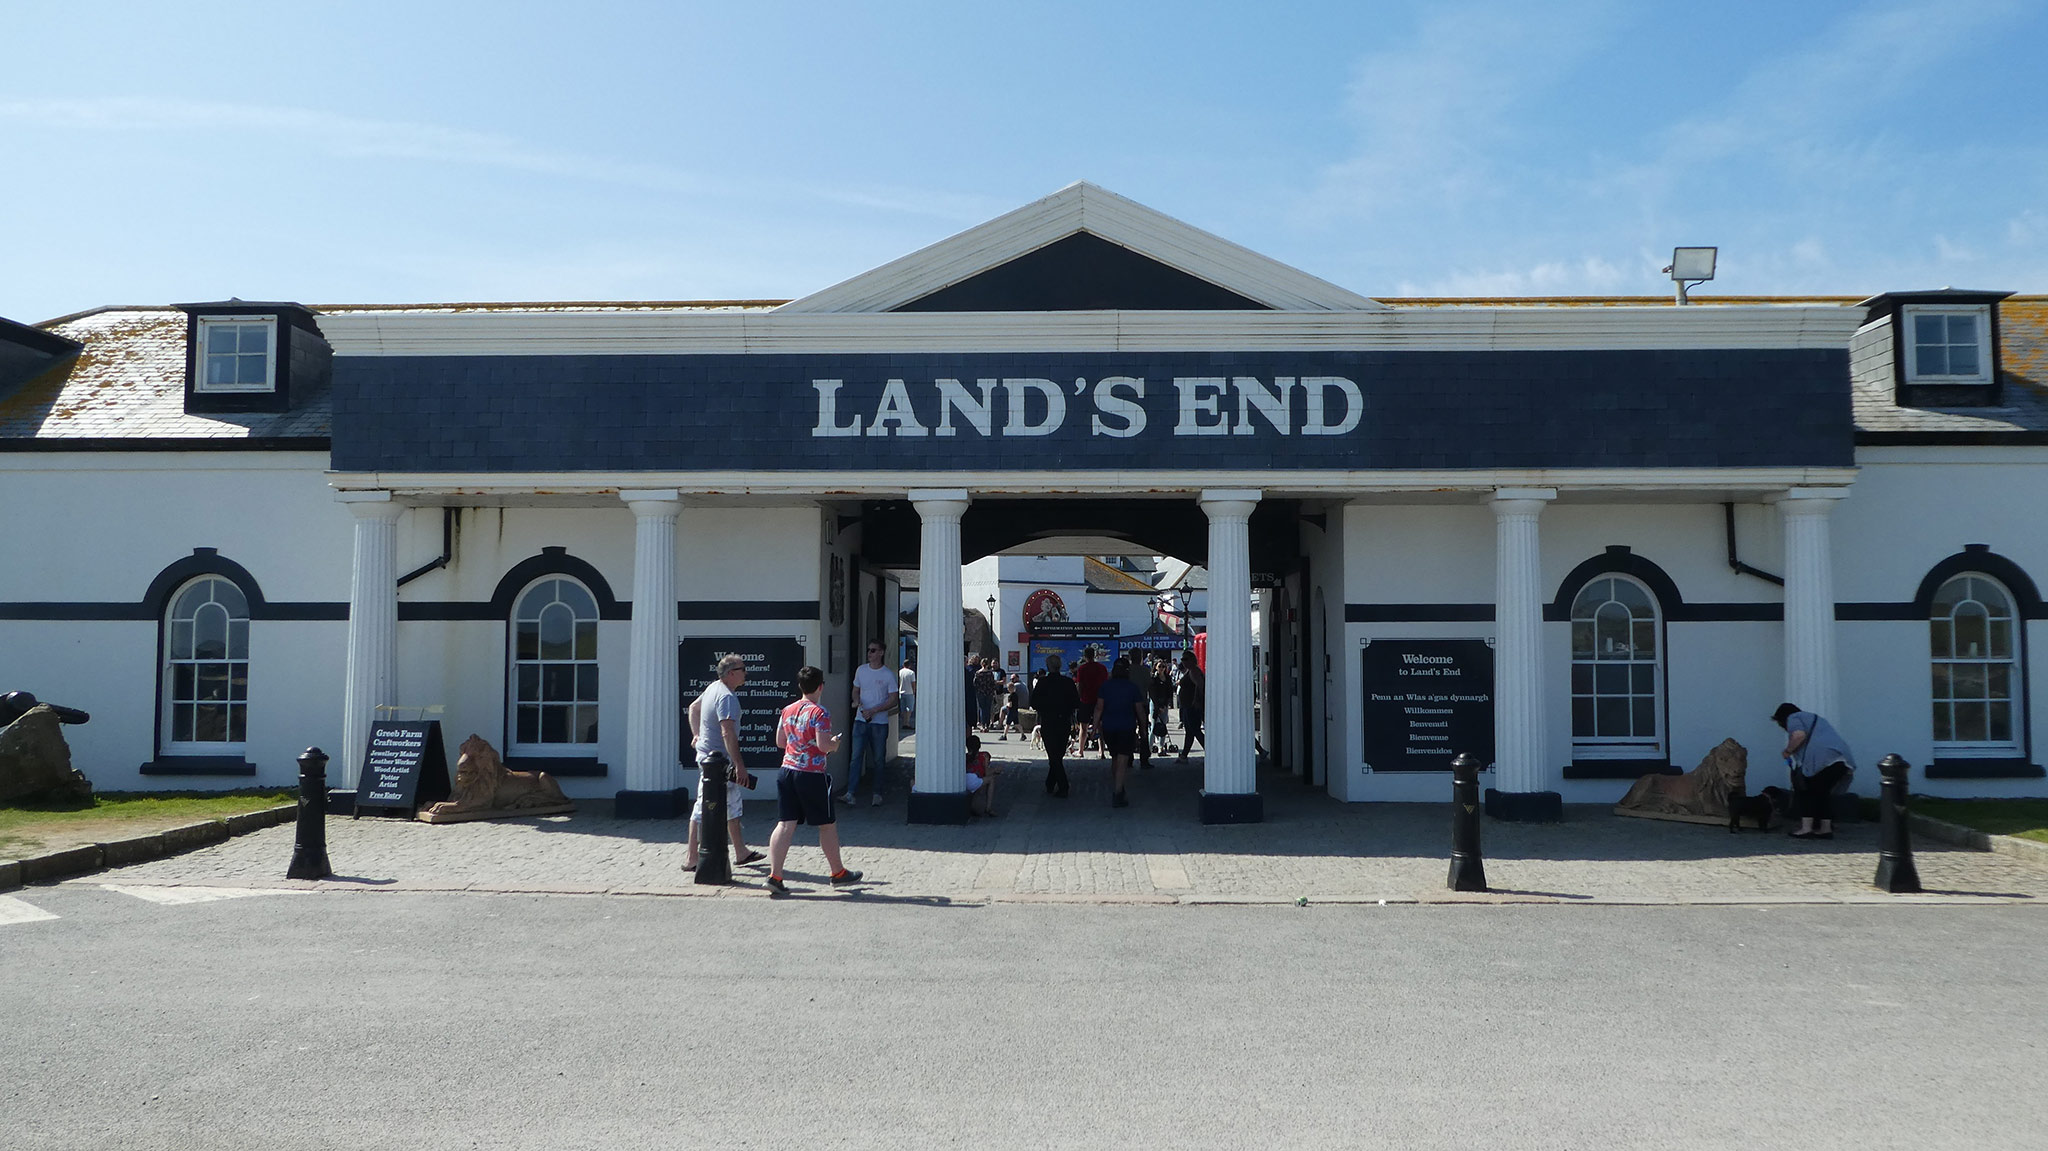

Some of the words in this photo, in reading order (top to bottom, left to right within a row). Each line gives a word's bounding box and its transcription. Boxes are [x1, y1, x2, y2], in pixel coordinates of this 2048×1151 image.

[811, 377, 1148, 438] LAND'S
[1173, 376, 1364, 437] END
[1251, 573, 1275, 582] ETS
[714, 652, 765, 662] Wome
[1402, 654, 1454, 664] Welcome
[1410, 668, 1441, 676] Land's
[1443, 668, 1461, 676] End
[744, 680, 780, 688] starting
[750, 690, 788, 698] finishing
[1450, 694, 1489, 702] dynnargh
[376, 728, 400, 738] Greeb
[400, 730, 423, 738] Farm
[373, 738, 422, 748] Craftworkers
[740, 745, 778, 753] reception
[370, 750, 400, 758] Jewellery
[384, 792, 402, 800] Entry
